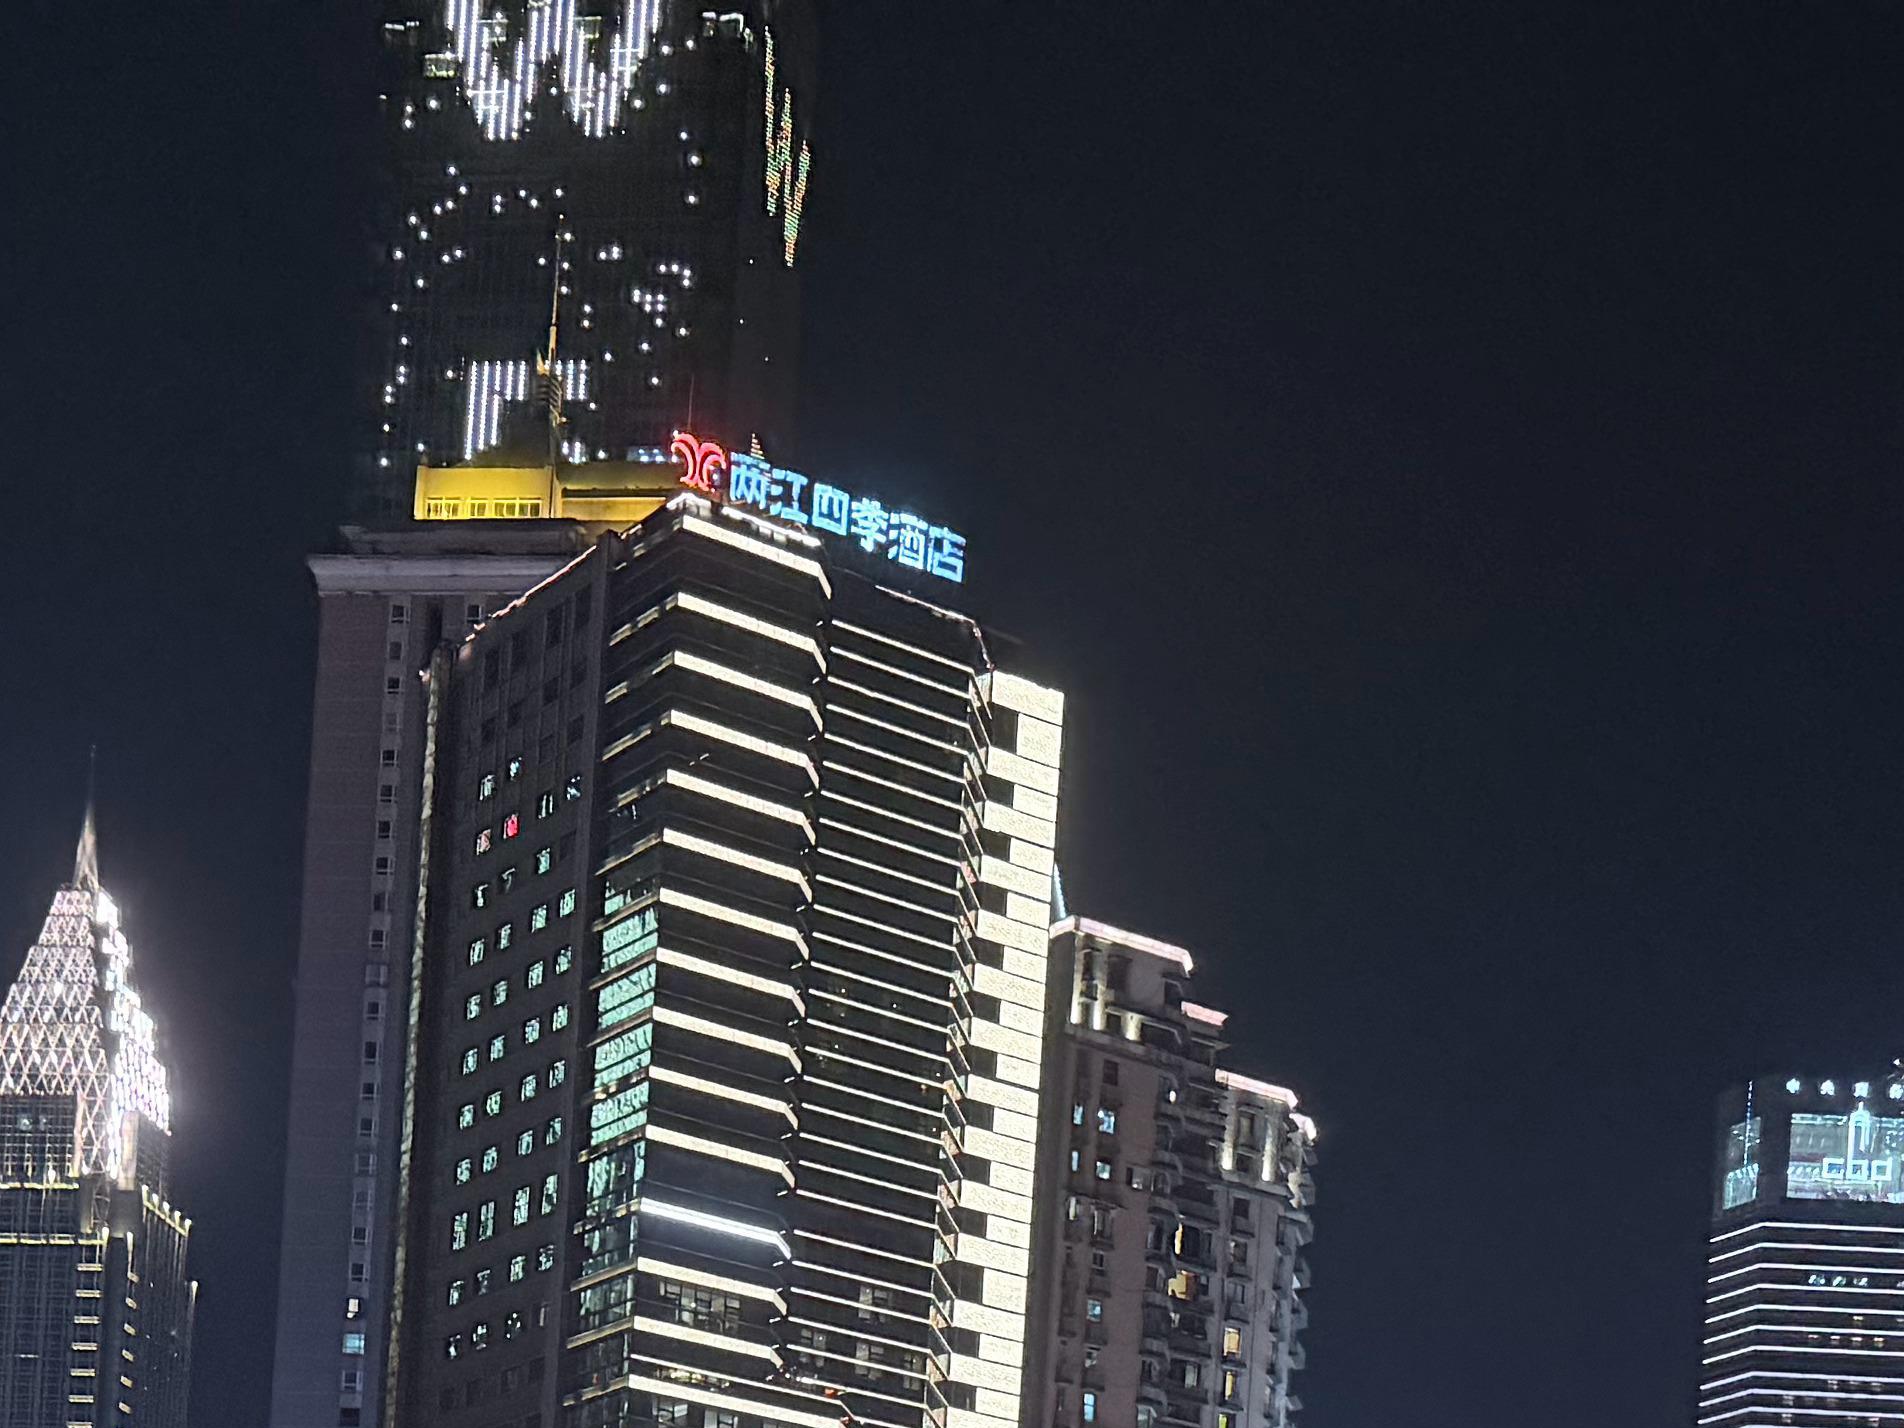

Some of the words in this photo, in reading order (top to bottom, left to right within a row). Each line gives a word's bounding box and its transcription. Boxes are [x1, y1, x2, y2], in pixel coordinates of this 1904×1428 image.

[730, 451, 967, 583] 两江四季酒店
